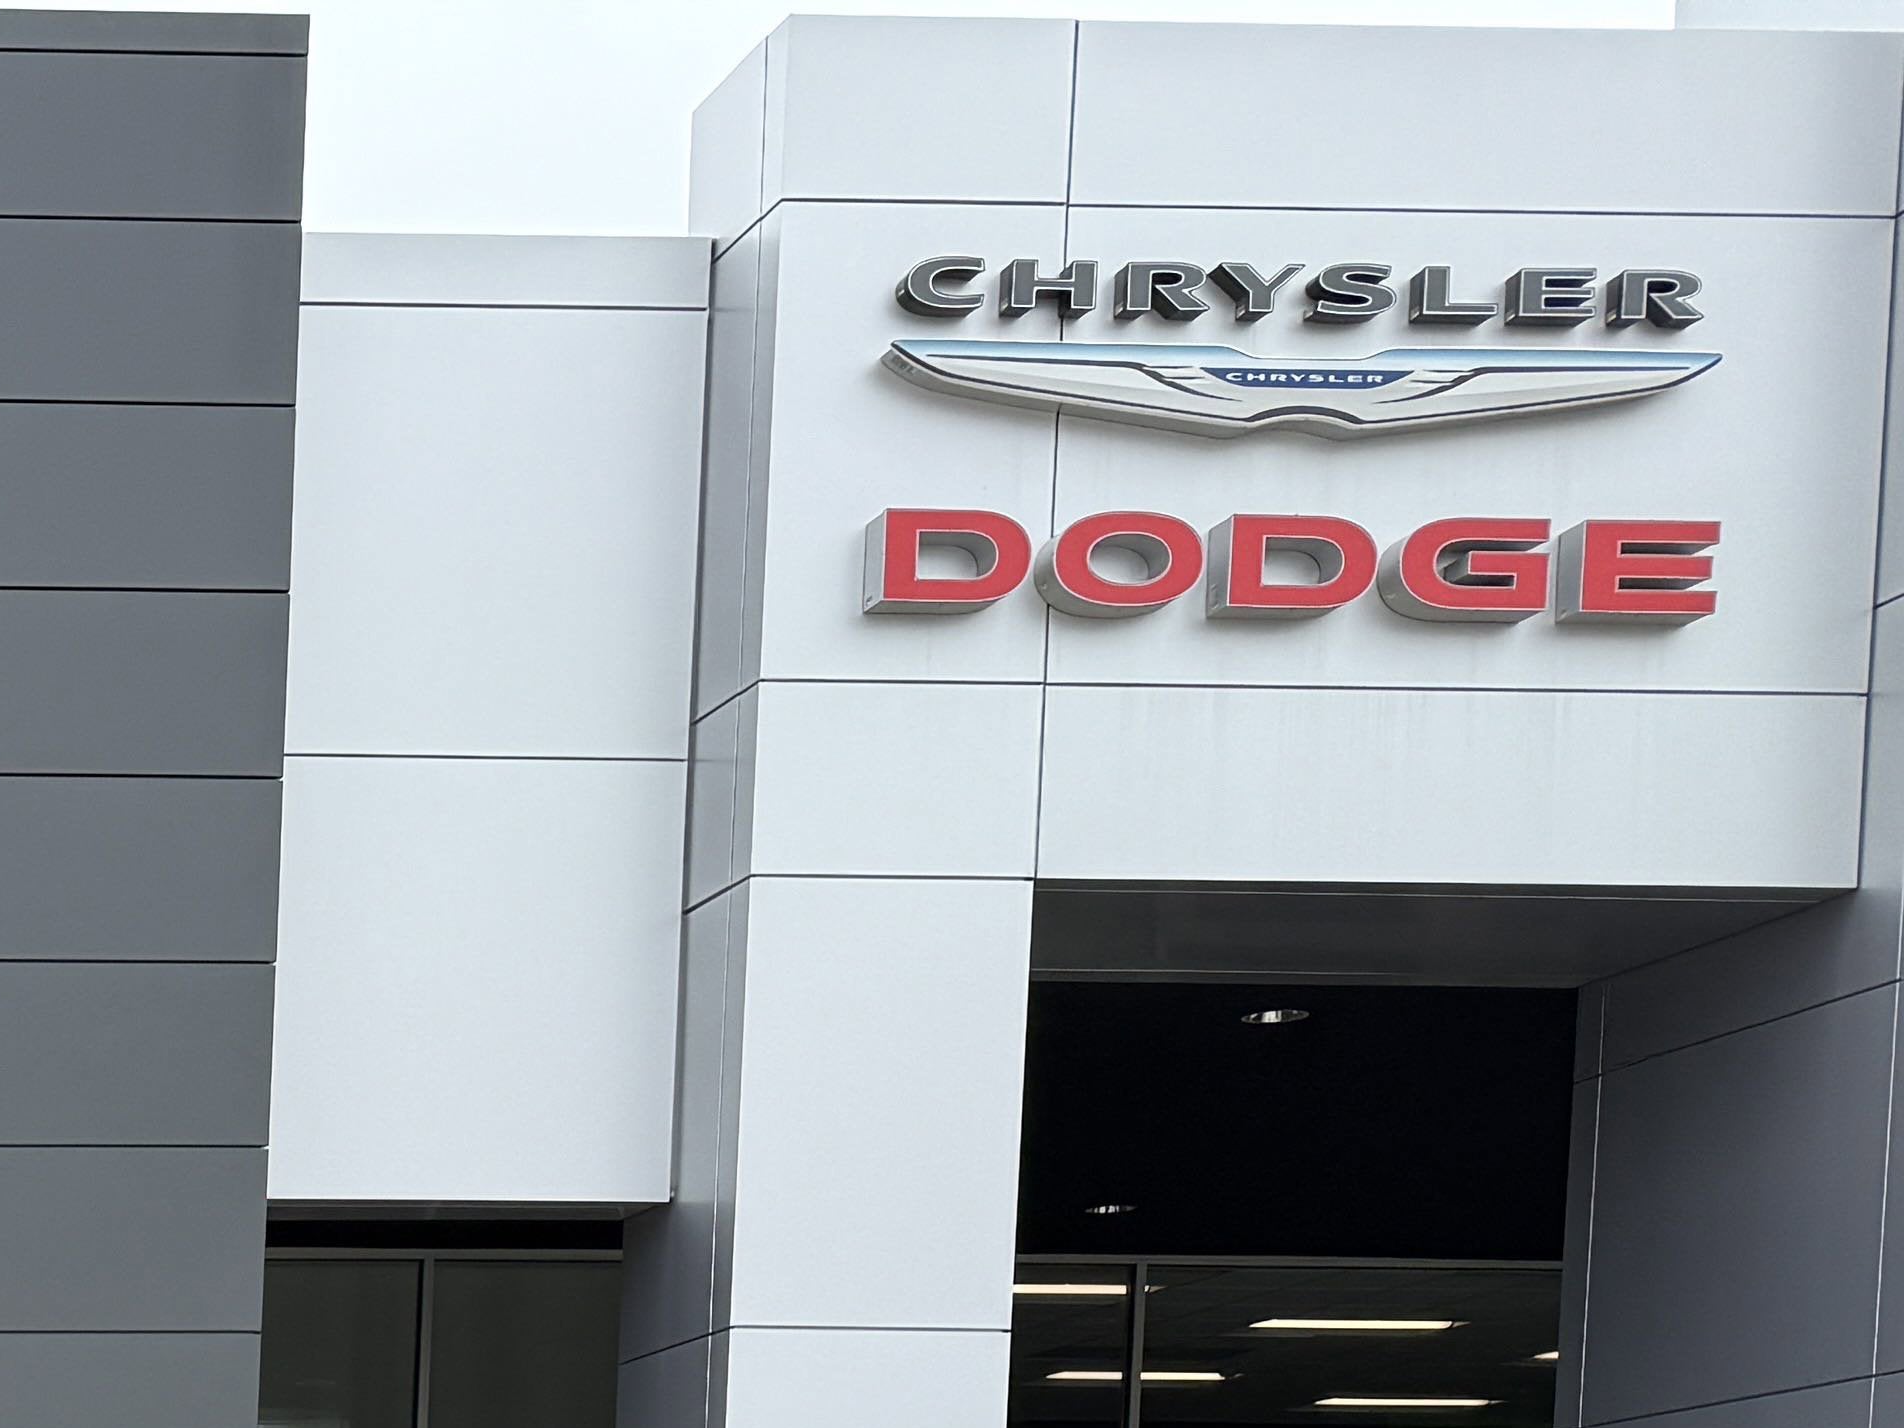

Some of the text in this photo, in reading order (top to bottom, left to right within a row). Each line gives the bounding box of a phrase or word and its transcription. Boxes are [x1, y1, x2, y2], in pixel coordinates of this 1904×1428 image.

[896, 254, 1706, 330] CHRYSLER
[1225, 371, 1384, 383] CHRYSLER
[864, 507, 1723, 627] DODGE
